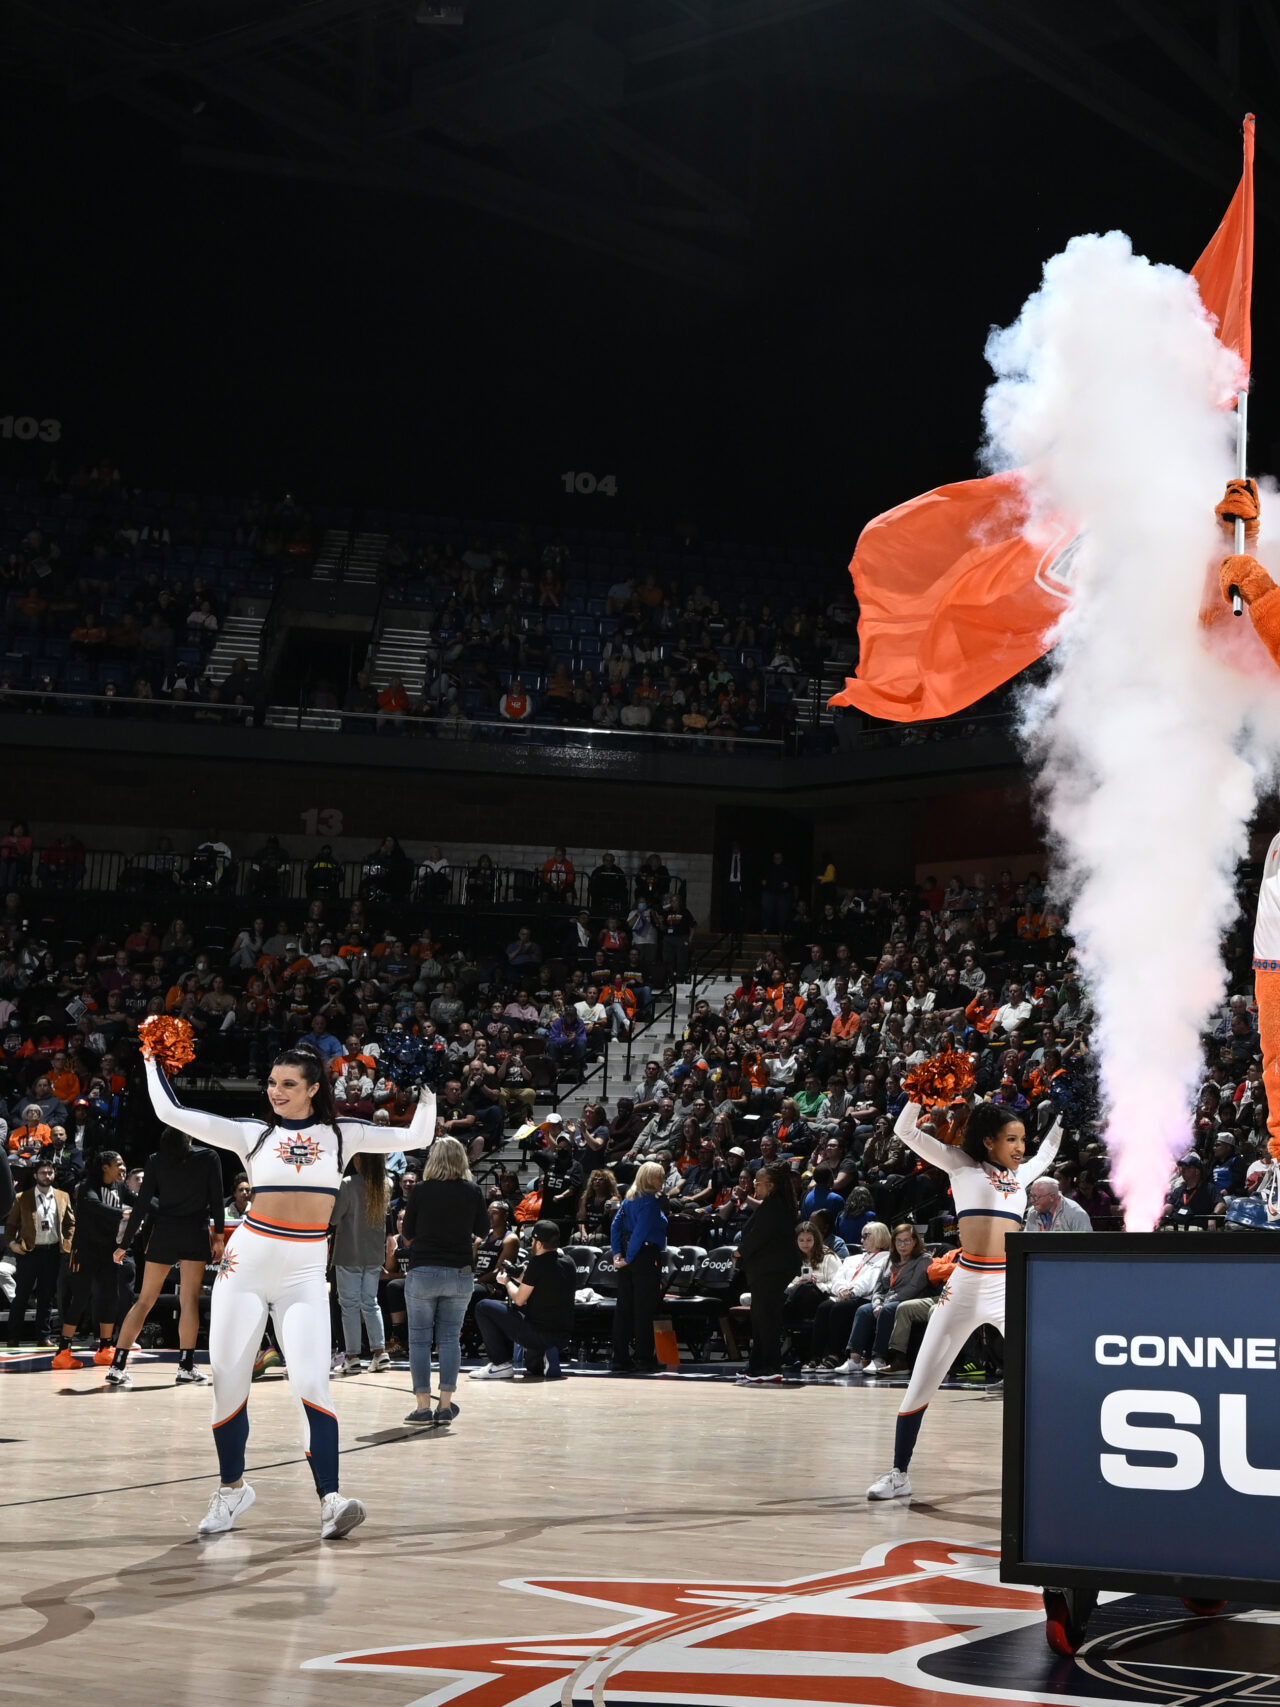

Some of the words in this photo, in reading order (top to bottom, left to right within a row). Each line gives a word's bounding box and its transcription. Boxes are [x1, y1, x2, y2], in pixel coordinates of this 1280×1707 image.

[0, 415, 62, 442] 103
[561, 470, 618, 496] 104
[302, 808, 346, 837] 13
[547, 1176, 564, 1189] 25
[476, 1256, 492, 1269] 25
[701, 1257, 733, 1273] Google
